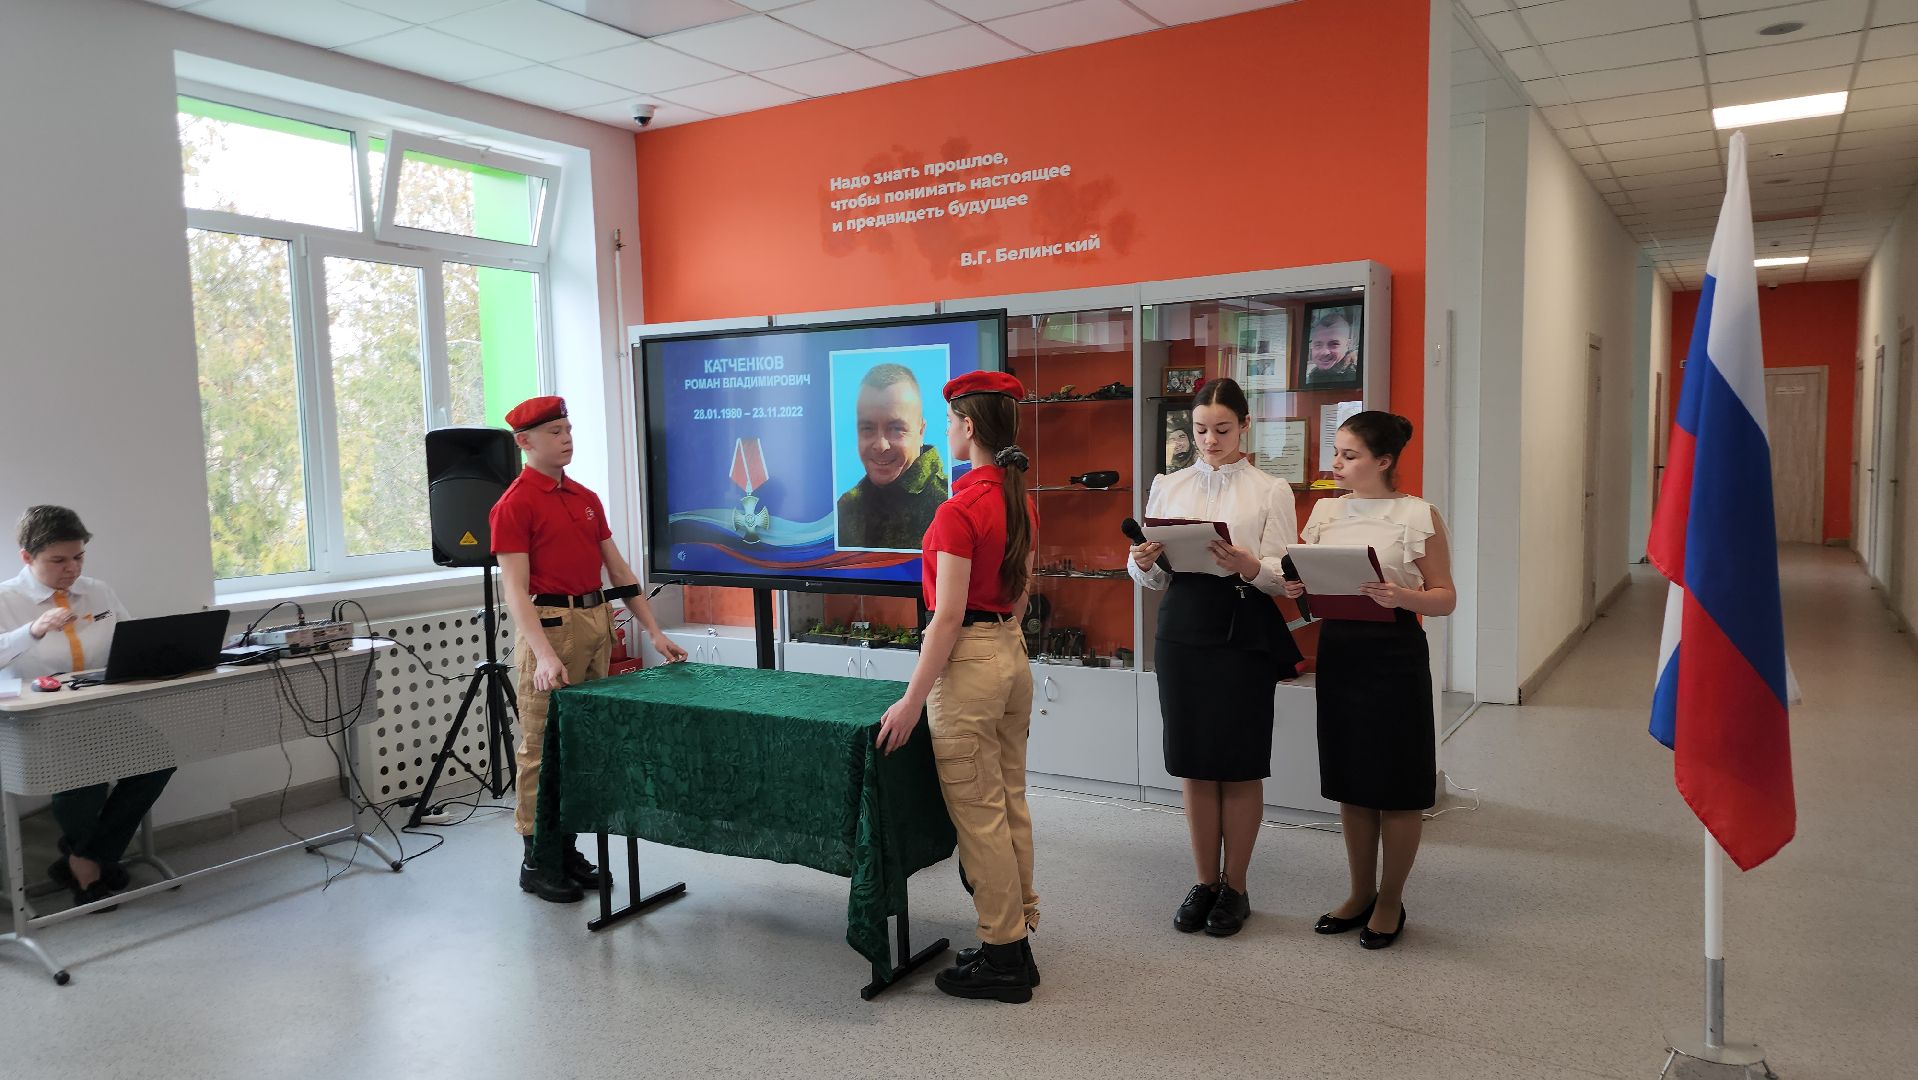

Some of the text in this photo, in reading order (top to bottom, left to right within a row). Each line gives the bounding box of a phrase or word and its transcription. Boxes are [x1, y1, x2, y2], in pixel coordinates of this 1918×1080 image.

[830, 152, 1009, 192] Надо знать прошлое,
[831, 164, 1072, 212] чтобы понимать настоящее
[832, 193, 1028, 233] и предвидеть будущее
[960, 250, 992, 267] В.Г.
[704, 356, 784, 373] КАТЧЕНКОВ
[684, 374, 811, 391] РОМАН ВЛАДИМИРОВИЧ
[694, 408, 742, 420] 28.01.1980
[753, 406, 803, 418] 23.11.2022
